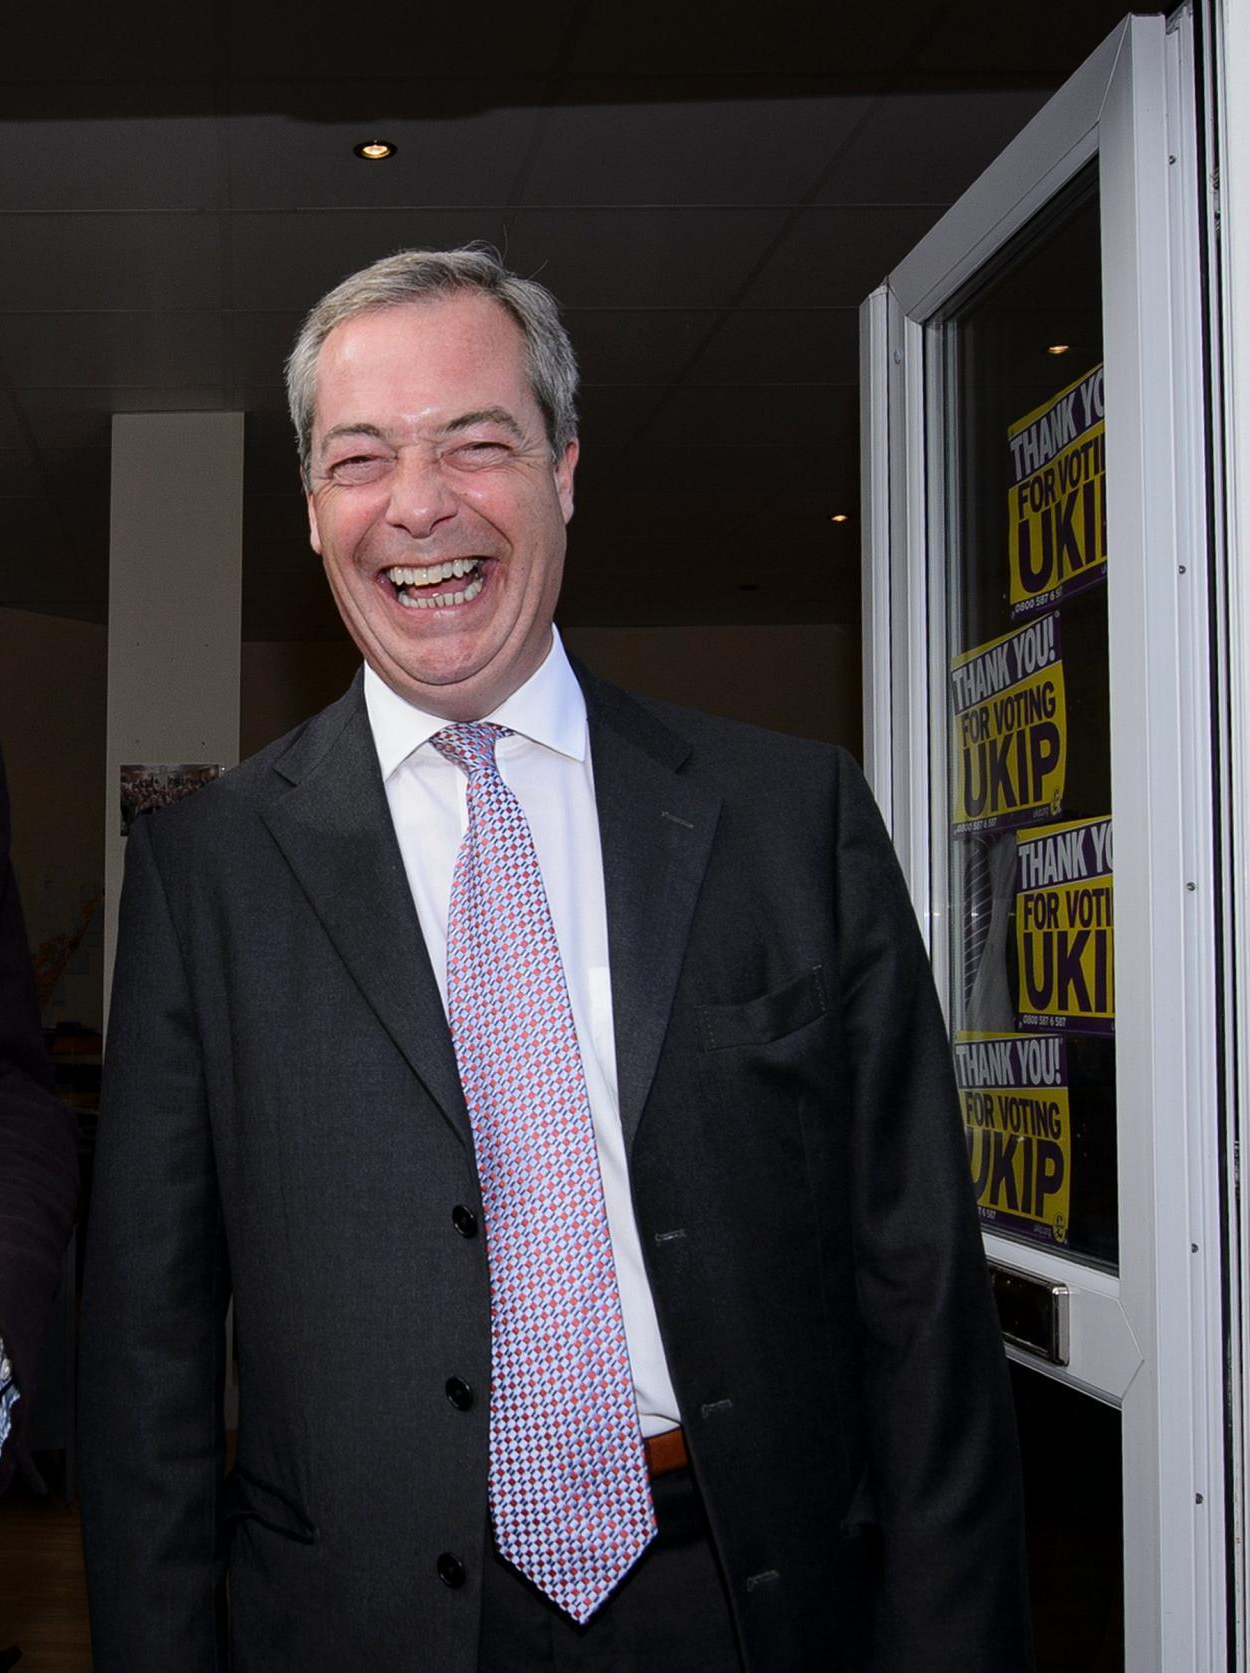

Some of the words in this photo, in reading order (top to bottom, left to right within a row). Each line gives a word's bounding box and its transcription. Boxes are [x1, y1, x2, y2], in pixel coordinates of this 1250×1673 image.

[1009, 391, 1078, 481] THANK
[1018, 467, 1057, 520] FOR
[1057, 434, 1105, 494] VOTI
[1017, 474, 1106, 594] UKI
[952, 642, 1011, 712] THANK
[1012, 616, 1054, 679] YOU!
[961, 706, 990, 748] FOR
[993, 681, 1056, 735] VOTING
[963, 721, 1061, 818] UKIP
[1018, 829, 1087, 889] THANK
[1024, 892, 1060, 930] FOR
[1066, 887, 1113, 929] VOTI
[1023, 929, 1114, 1013] UKI
[956, 1041, 1014, 1087] THANK
[1016, 1037, 1061, 1086] YOU!
[964, 1091, 994, 1128] FOR
[997, 1095, 1061, 1140] VOTING
[966, 1127, 1064, 1217] UKIP
